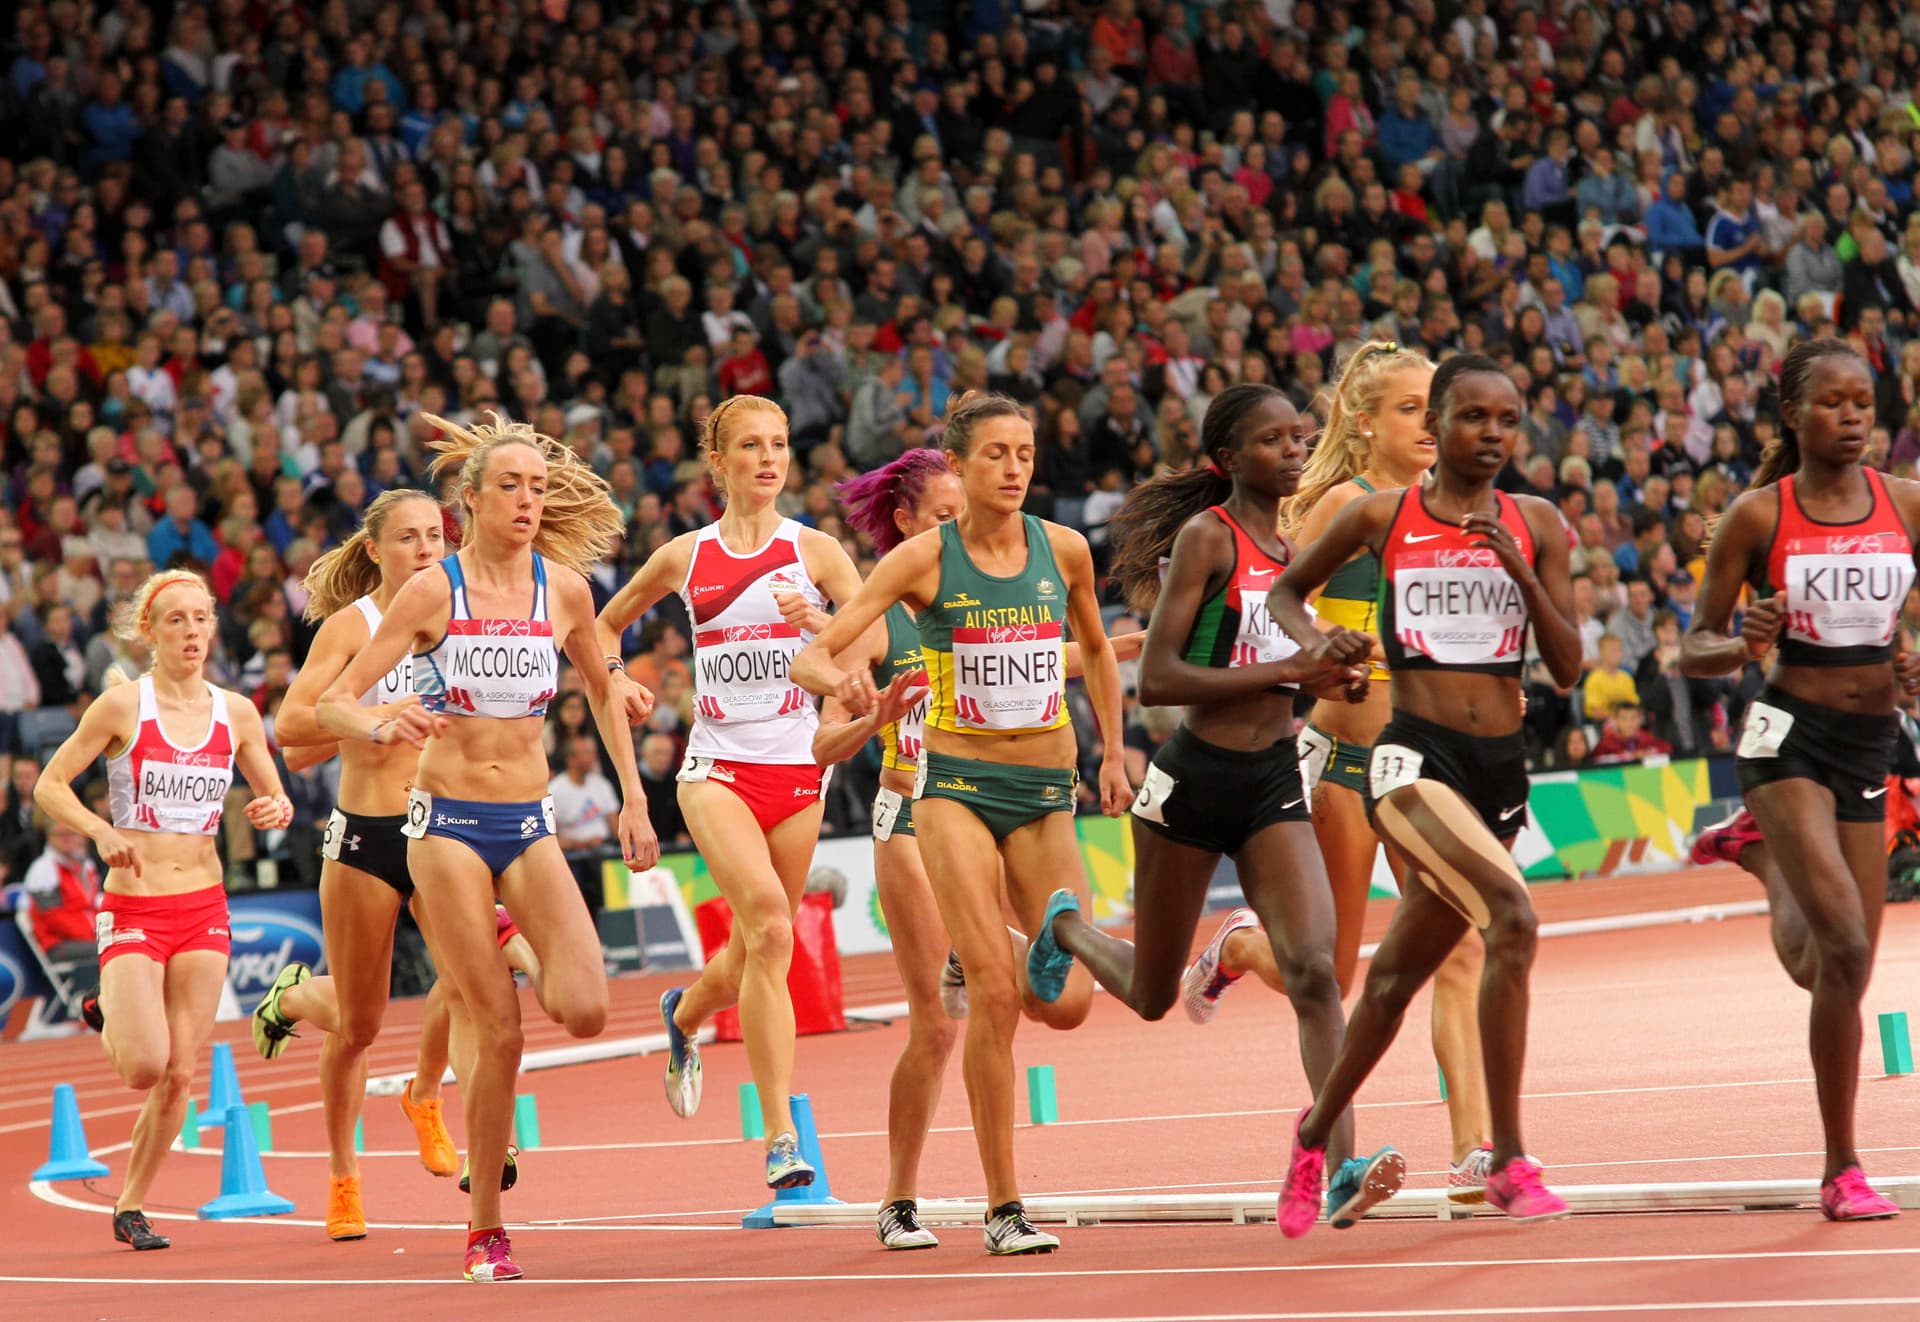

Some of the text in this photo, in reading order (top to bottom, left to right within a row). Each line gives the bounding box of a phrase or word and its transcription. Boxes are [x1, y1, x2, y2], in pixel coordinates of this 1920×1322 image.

[699, 584, 725, 593] KUKRI
[1805, 567, 1902, 601] KIRUI
[943, 599, 982, 609] DIADORA
[1405, 581, 1522, 616] CHEYWA
[965, 604, 1054, 629] AUSTRALIA
[453, 646, 552, 678] MCCOLGAN
[701, 649, 795, 685] WOOLVEN
[961, 651, 1058, 686] HEINER
[475, 691, 516, 700] GLASGOW
[723, 695, 762, 703] GLASGOW
[983, 700, 1024, 709] GLASGOW
[145, 771, 226, 802] BAMFORD
[936, 782, 978, 793] DIADORA
[447, 817, 478, 825] KUKRI
